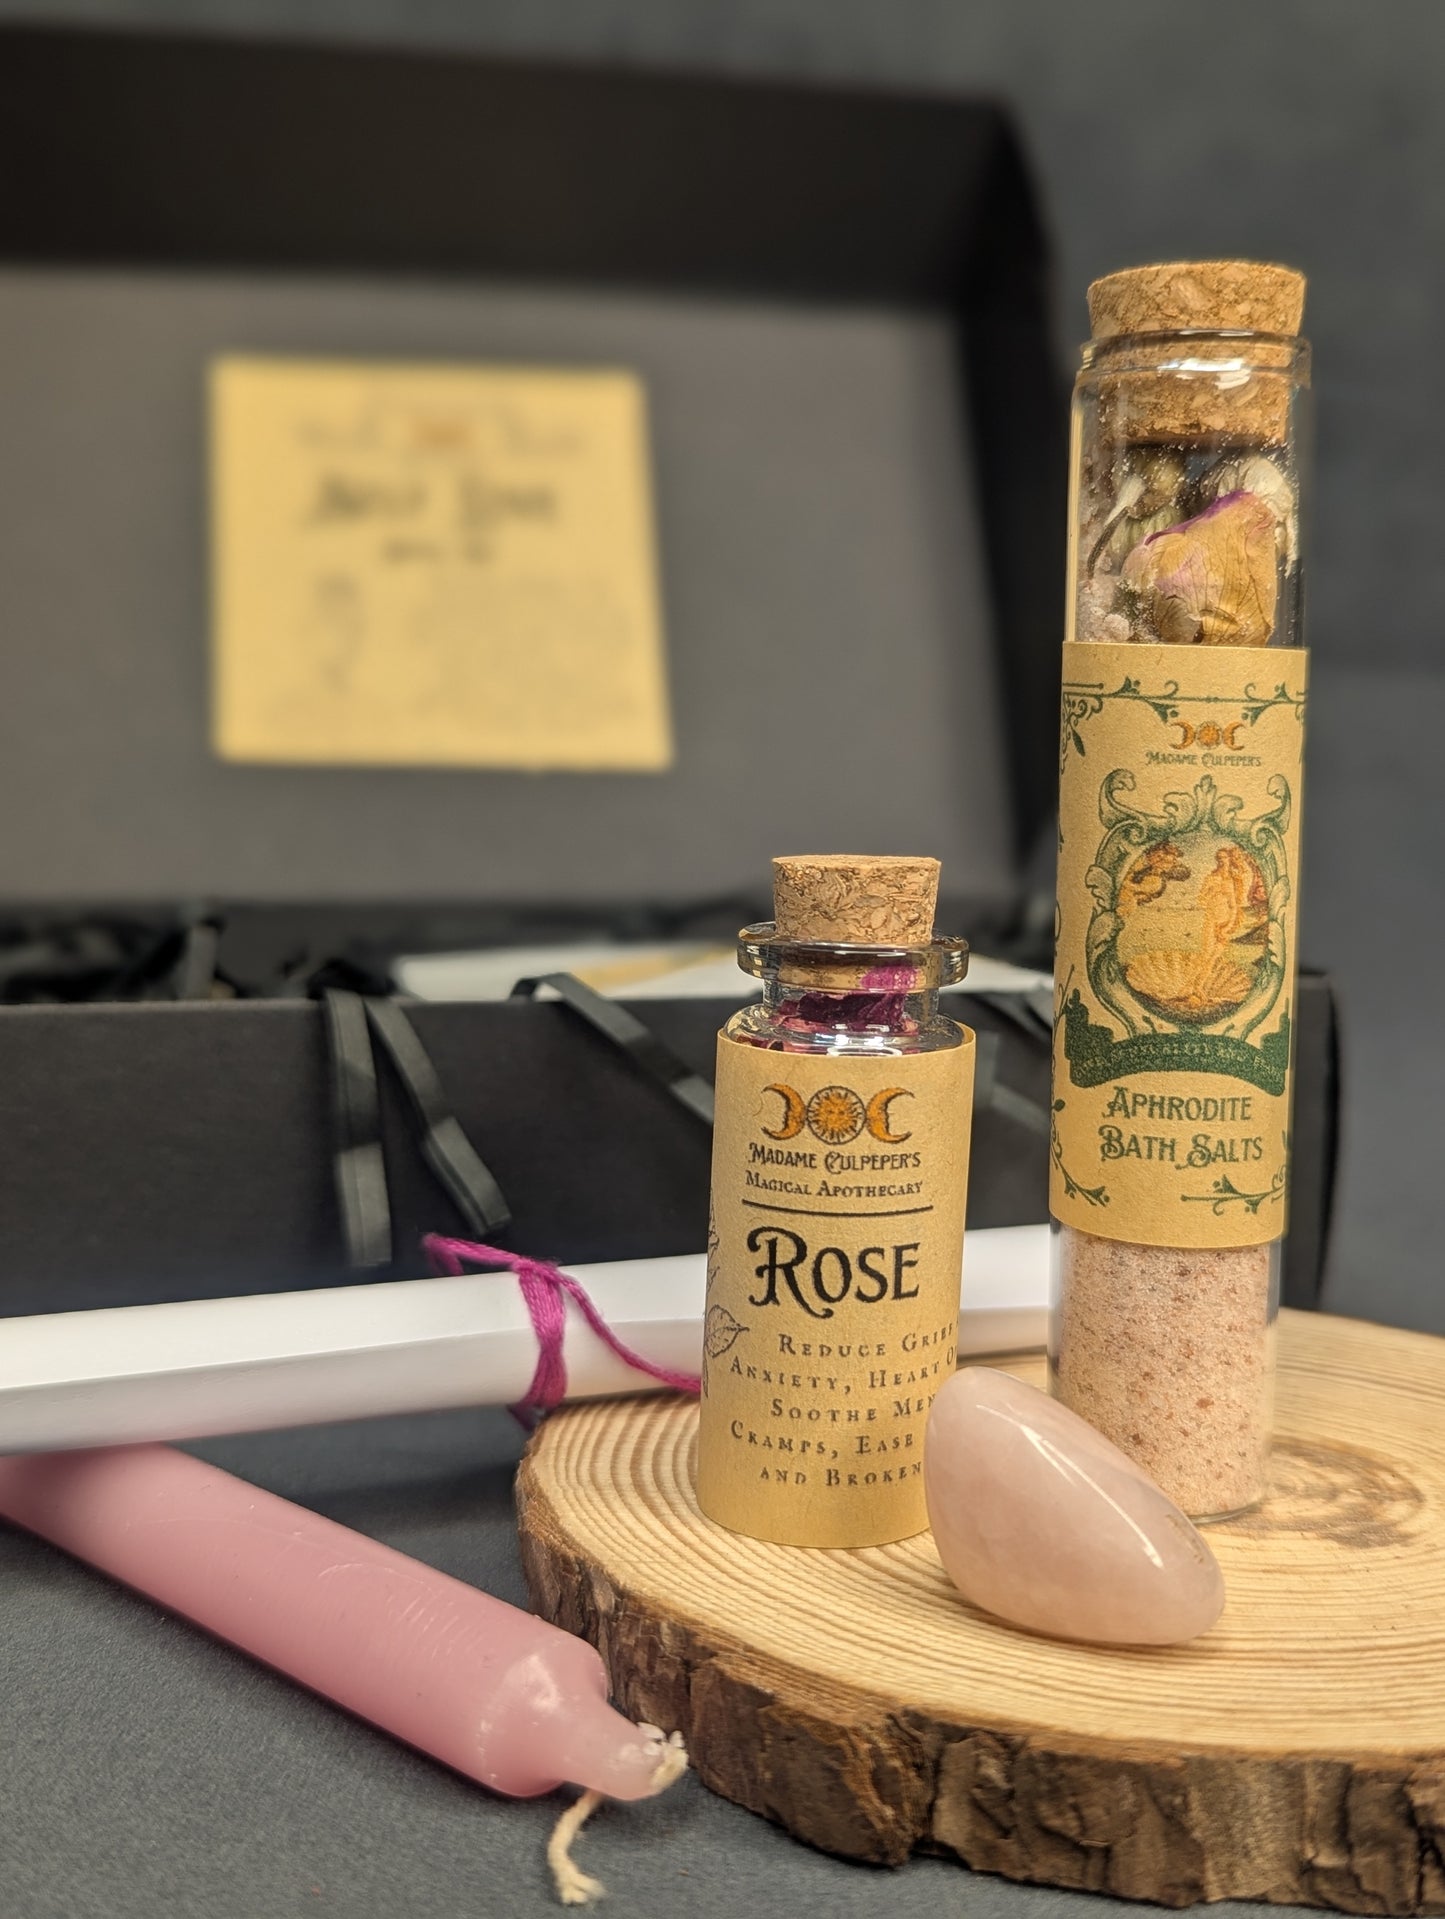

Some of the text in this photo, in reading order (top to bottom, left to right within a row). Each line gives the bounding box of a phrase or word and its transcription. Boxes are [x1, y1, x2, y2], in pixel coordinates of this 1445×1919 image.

[1145, 752, 1198, 765] MADAME
[1102, 1086, 1253, 1122] APHRODITE
[748, 1142, 922, 1175] MADAME CULPEPER'S
[1098, 1124, 1263, 1170] BATH SALTS
[745, 1169, 924, 1198] MAGICAL APOTHECARY
[747, 1226, 921, 1319] ROSE
[778, 1333, 886, 1358] REDUCE
[730, 1355, 940, 1396] ANXIETY, HEART
[770, 1398, 878, 1423] SOOTHE
[730, 1419, 914, 1459] CRAMPS, EASE
[760, 1461, 922, 1487] AND BROKEN
